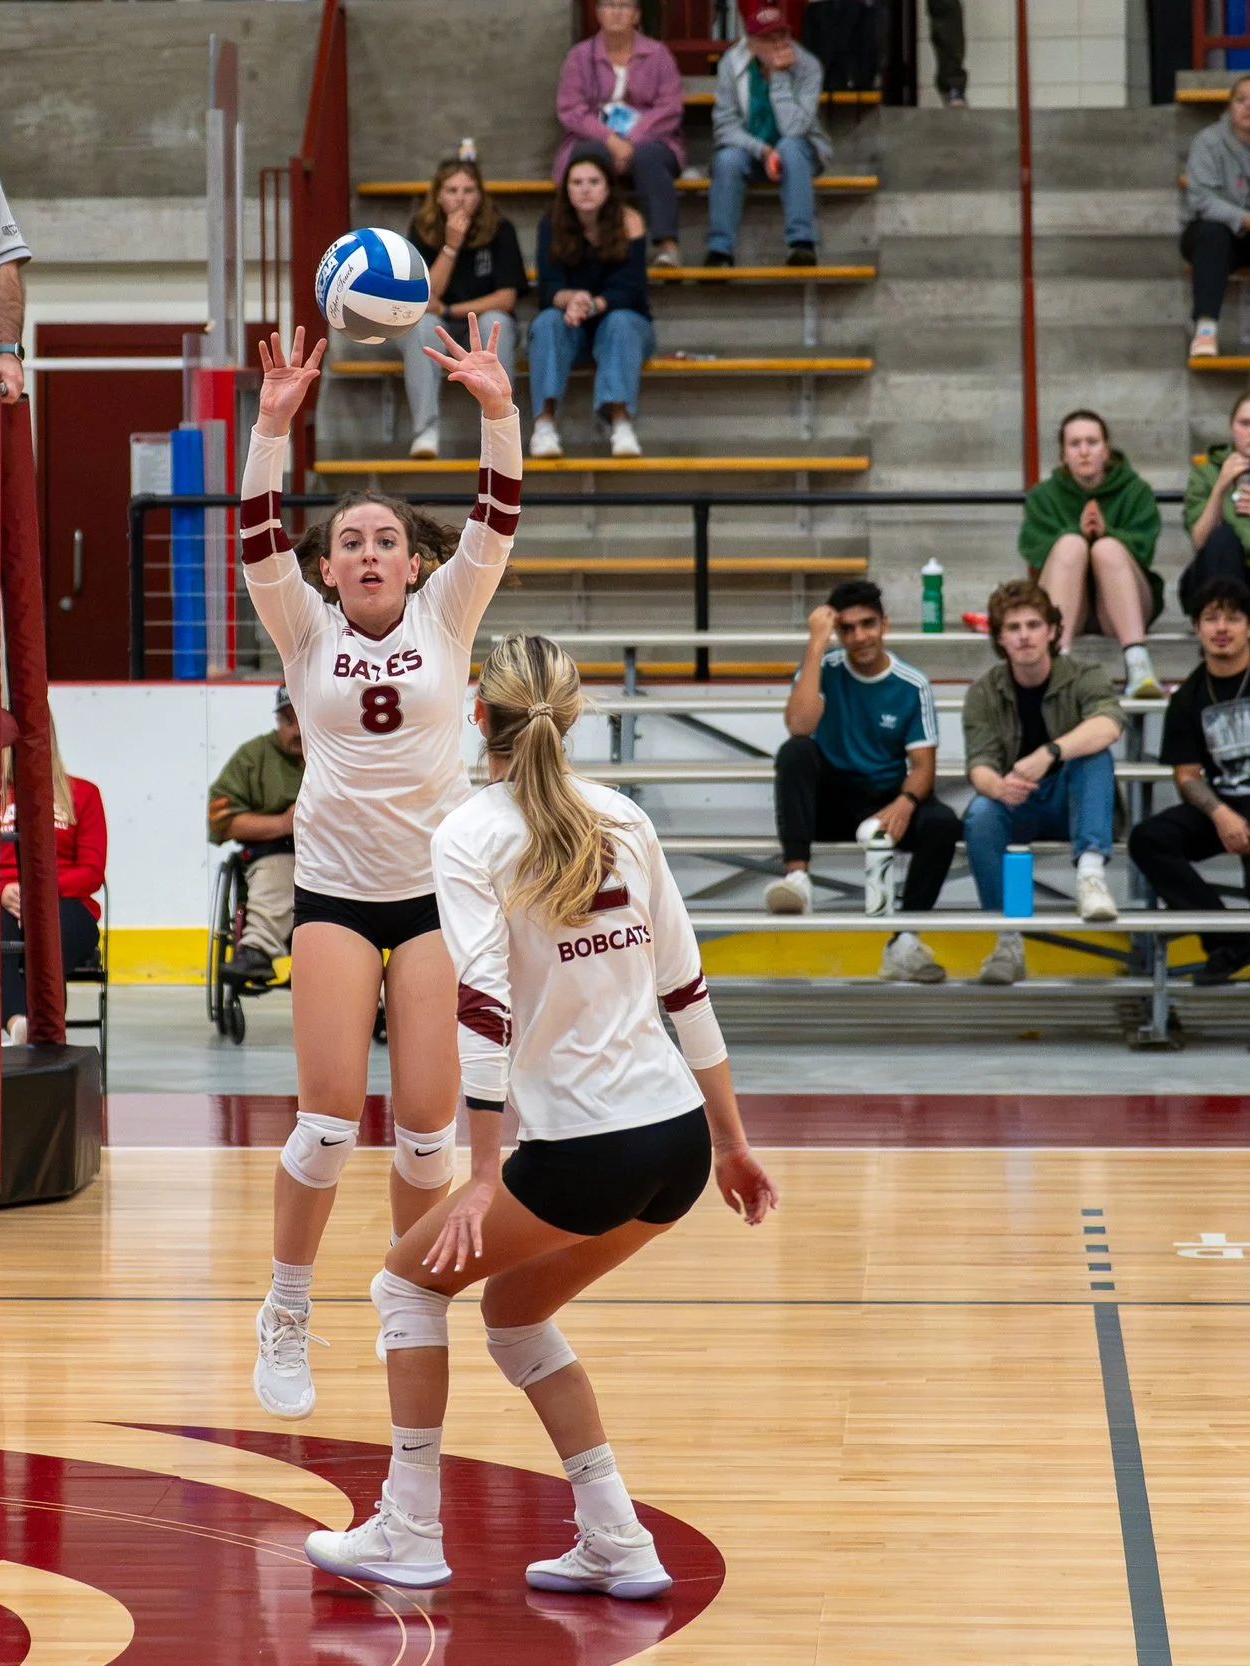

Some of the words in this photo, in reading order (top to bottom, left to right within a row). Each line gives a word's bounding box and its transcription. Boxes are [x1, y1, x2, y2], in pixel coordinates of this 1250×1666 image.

[337, 264, 355, 293] Touch
[333, 648, 423, 682] BATES
[359, 684, 405, 736] 8
[556, 924, 652, 963] BOBCATS
